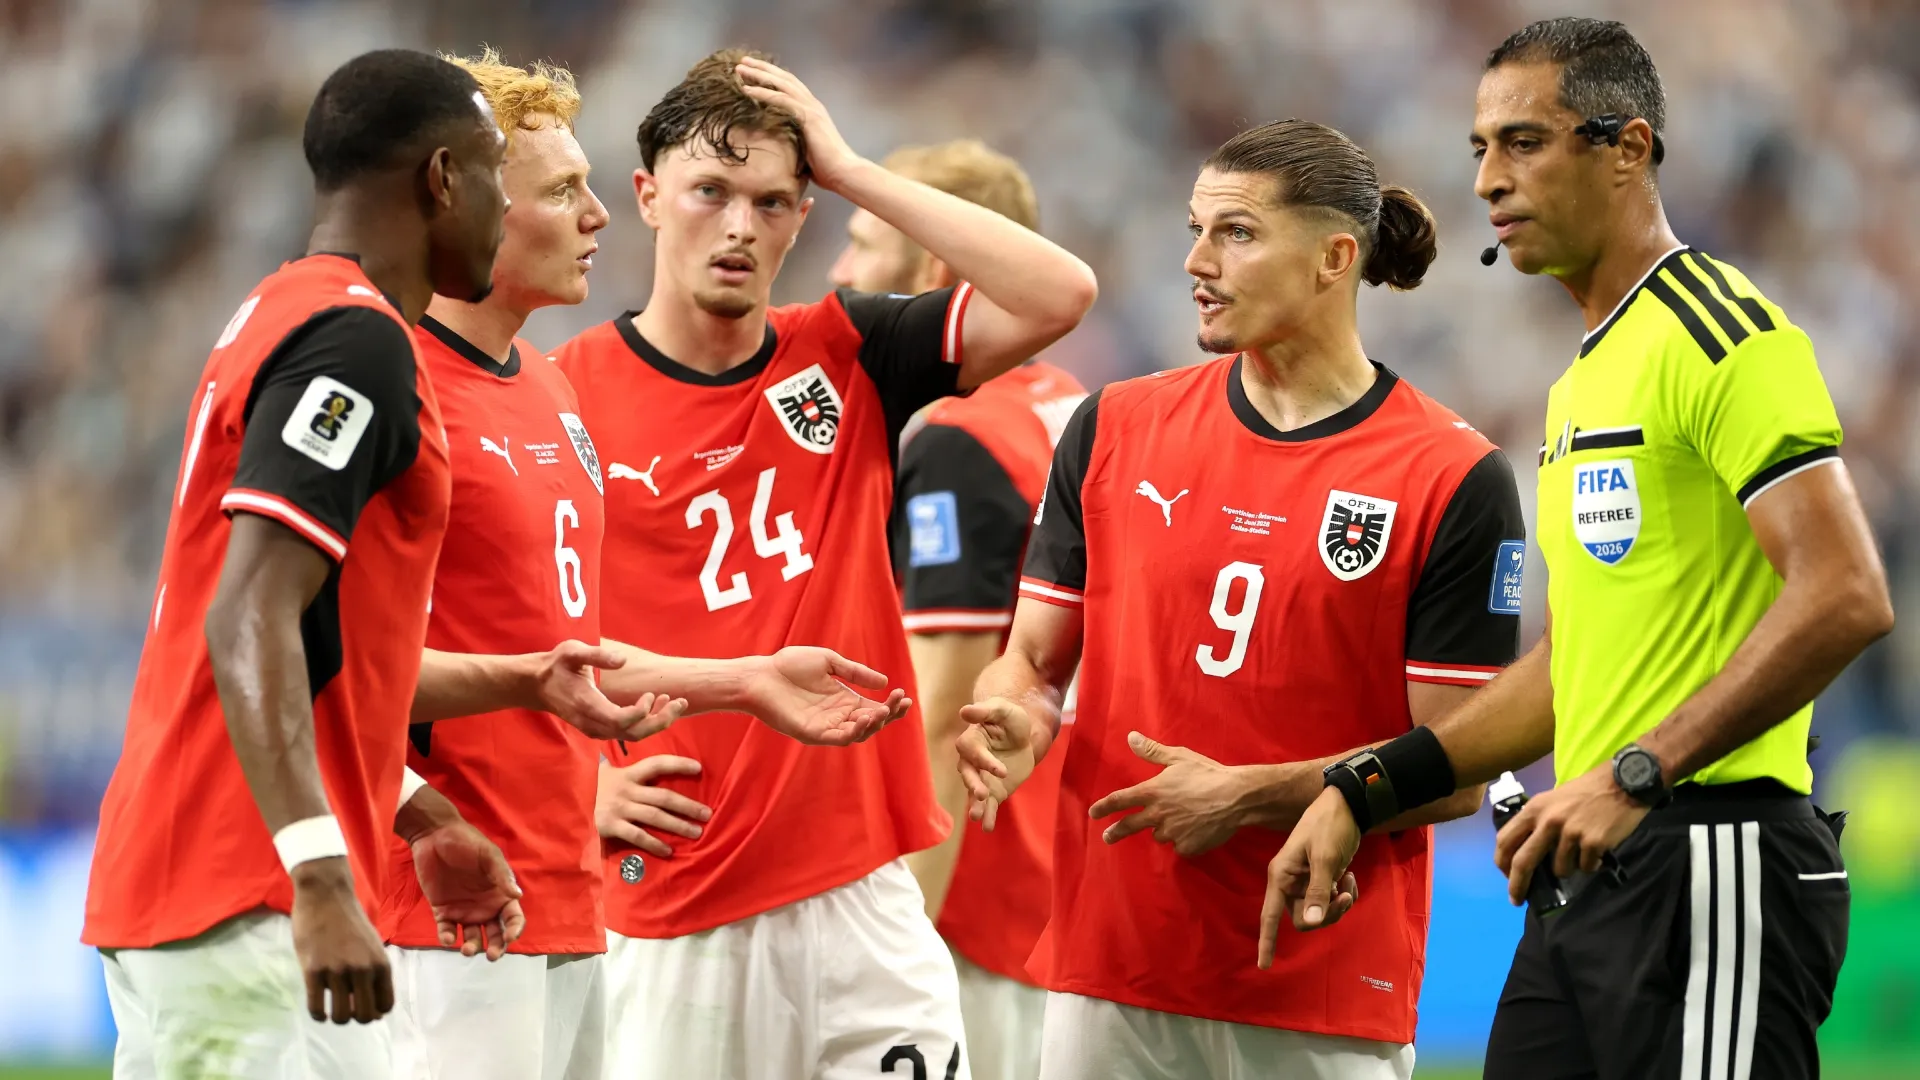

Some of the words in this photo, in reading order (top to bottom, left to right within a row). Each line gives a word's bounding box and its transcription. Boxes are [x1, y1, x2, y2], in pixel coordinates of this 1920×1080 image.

[1578, 467, 1629, 495] FIFA
[1221, 505, 1255, 519] Argentinien
[1347, 497, 1376, 511] ÖFB
[1578, 508, 1635, 525] REFEREE
[684, 466, 815, 613] 24
[554, 499, 587, 618] 6
[1596, 543, 1624, 557] 2026
[1507, 599, 1521, 607] FIFA
[1195, 560, 1265, 678] 9
